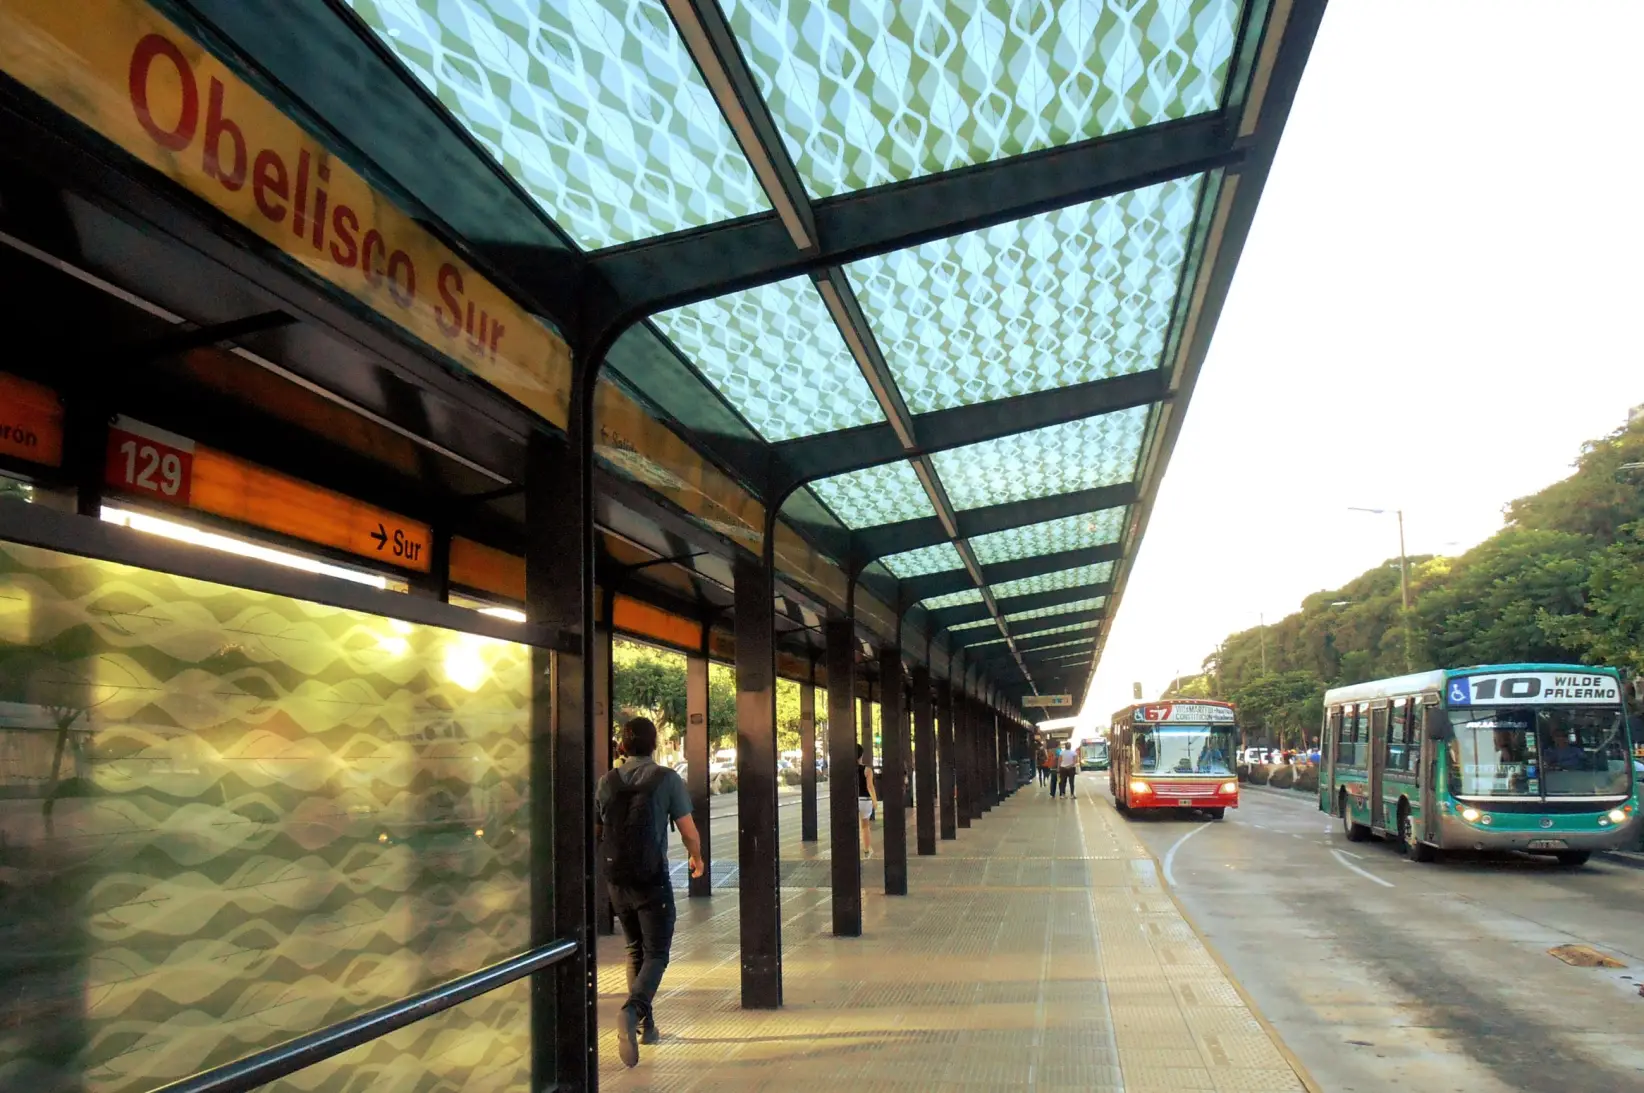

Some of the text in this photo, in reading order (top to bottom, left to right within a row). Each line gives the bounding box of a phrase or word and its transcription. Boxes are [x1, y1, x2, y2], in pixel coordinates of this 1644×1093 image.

[129, 33, 506, 361] Obelisco Sur
[0, 424, 37, 446] rón
[121, 440, 181, 496] 129
[393, 529, 421, 560] Sur
[1472, 678, 1541, 699] 10
[1555, 677, 1601, 687] WILDE
[1544, 688, 1616, 699] PALERMO
[1145, 705, 1172, 720] 67
